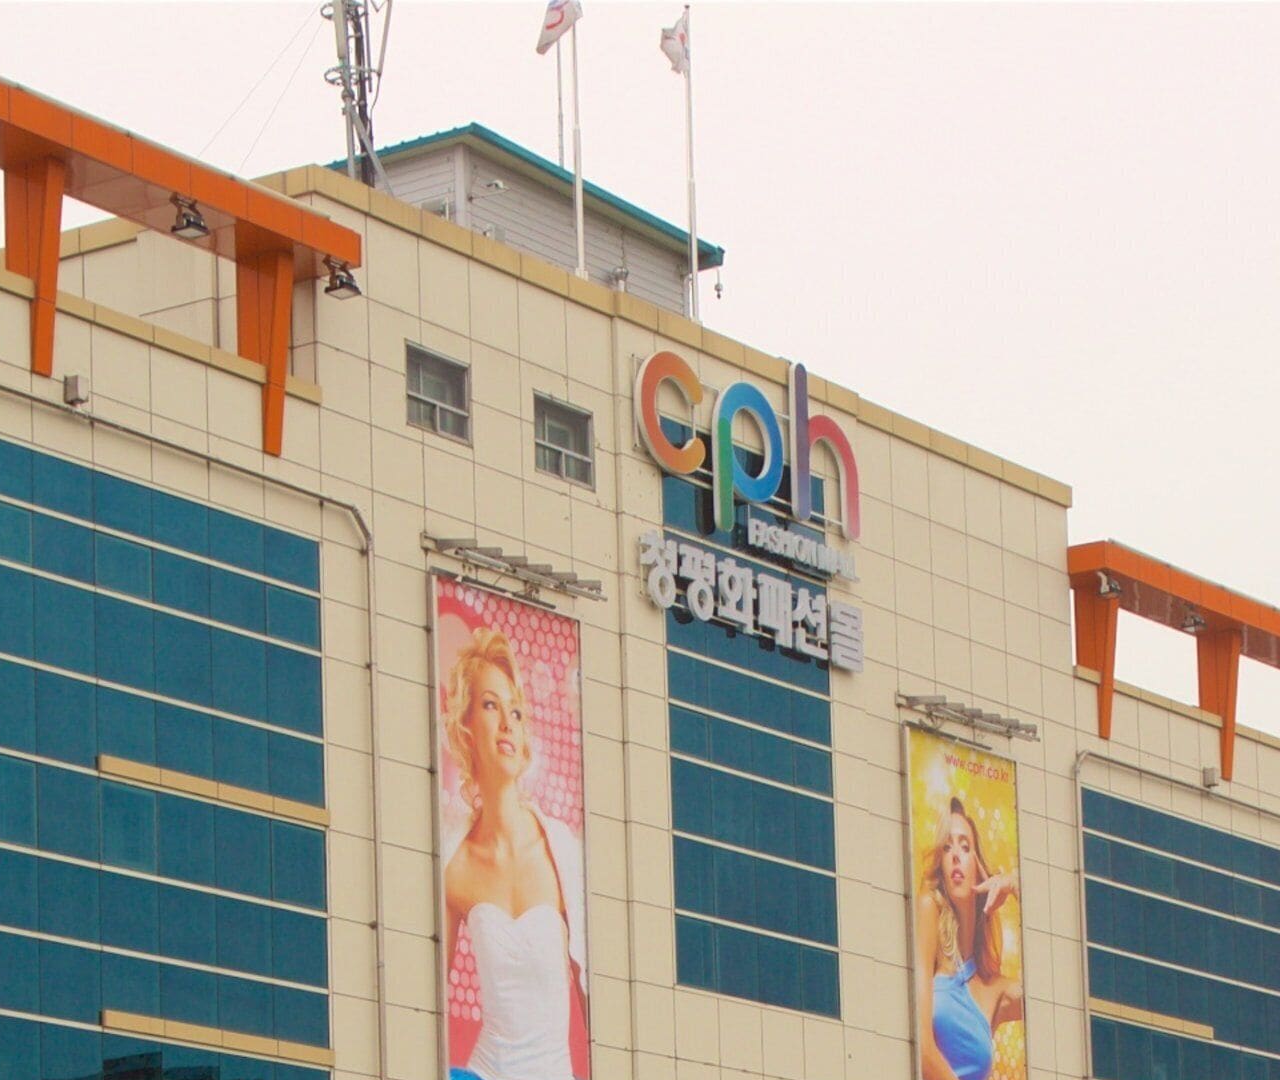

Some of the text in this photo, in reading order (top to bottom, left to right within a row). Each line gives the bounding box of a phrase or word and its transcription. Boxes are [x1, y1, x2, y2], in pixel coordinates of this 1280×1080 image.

[635, 350, 860, 541] cph
[748, 518, 818, 567] FASHION
[639, 530, 864, 674] 청평화패션몰
[945, 752, 1010, 783] www.cph.co.kr
